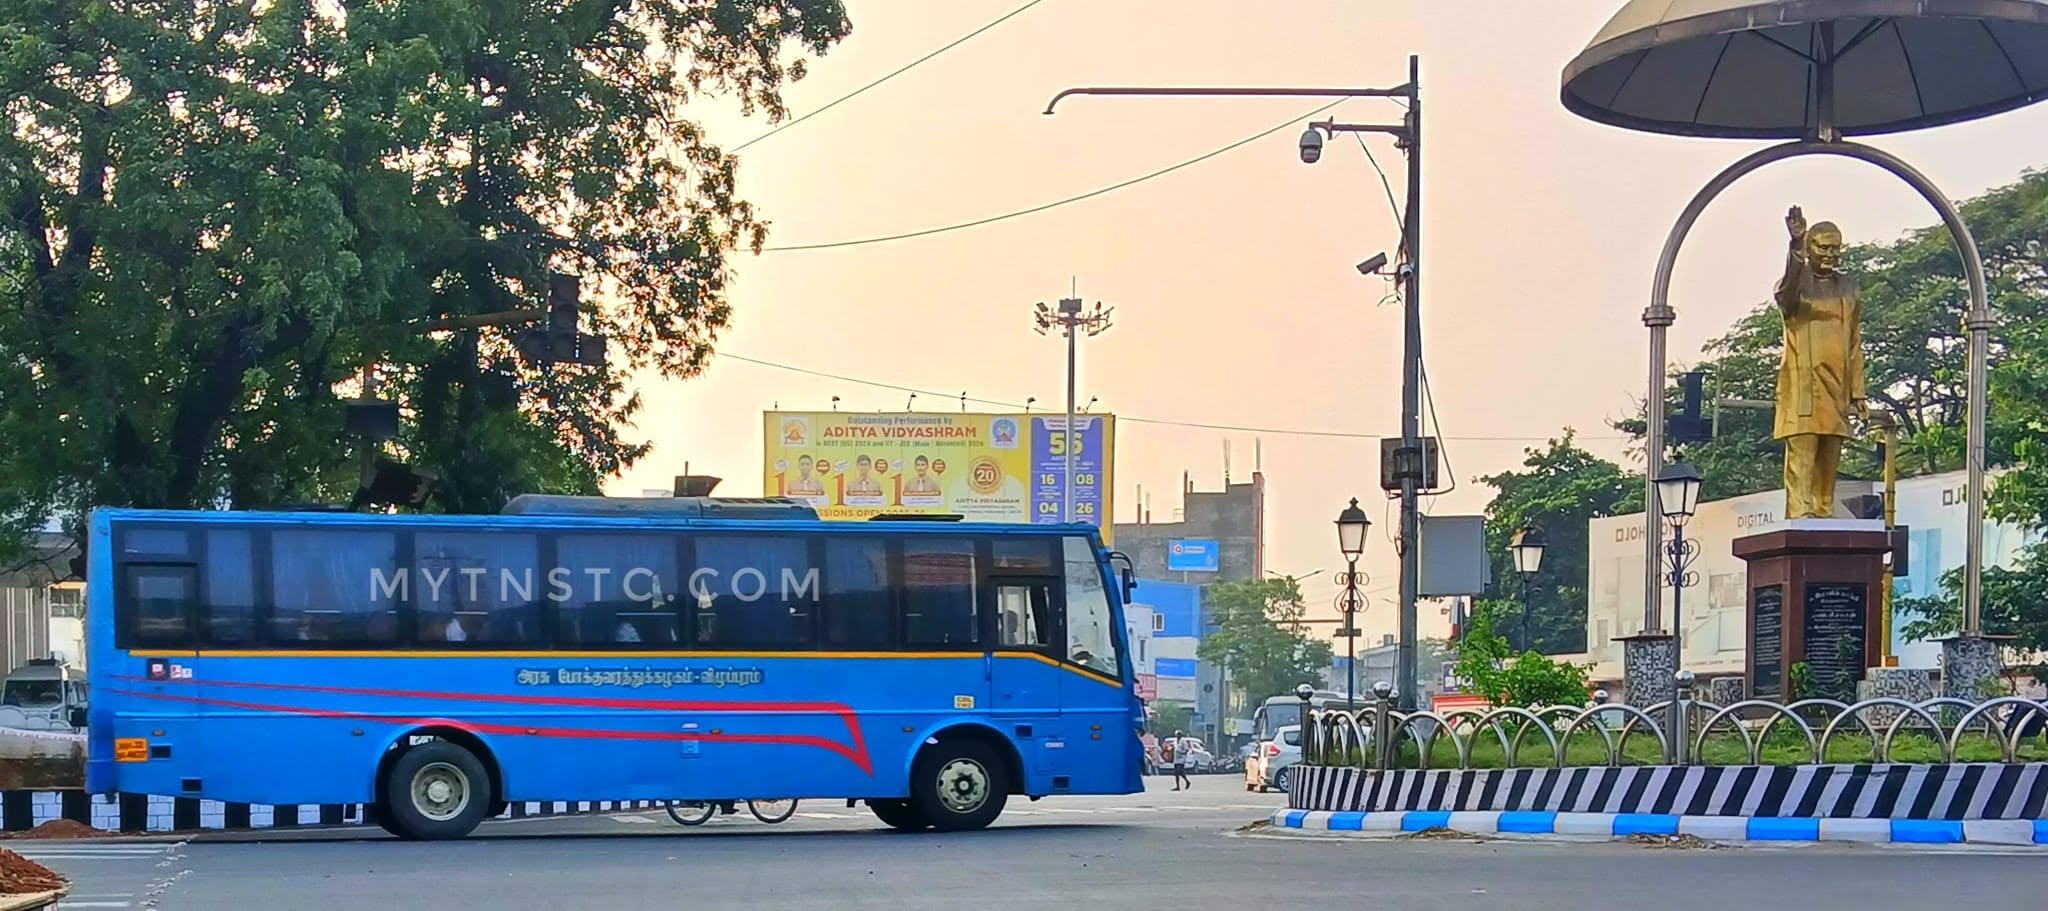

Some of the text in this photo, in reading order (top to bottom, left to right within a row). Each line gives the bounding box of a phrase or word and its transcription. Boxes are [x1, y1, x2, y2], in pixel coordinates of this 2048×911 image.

[848, 416, 952, 425] Outstanding Performance by
[824, 427, 977, 438] ADITYA VIDYASHRAM
[976, 469, 995, 482] 20
[1040, 474, 1055, 485] 16
[1076, 474, 1094, 485] 08
[833, 473, 848, 506] 1
[891, 473, 905, 506] 1
[1039, 502, 1058, 513] 04
[1076, 502, 1094, 513] 26
[1737, 511, 1775, 528] DIGITAL
